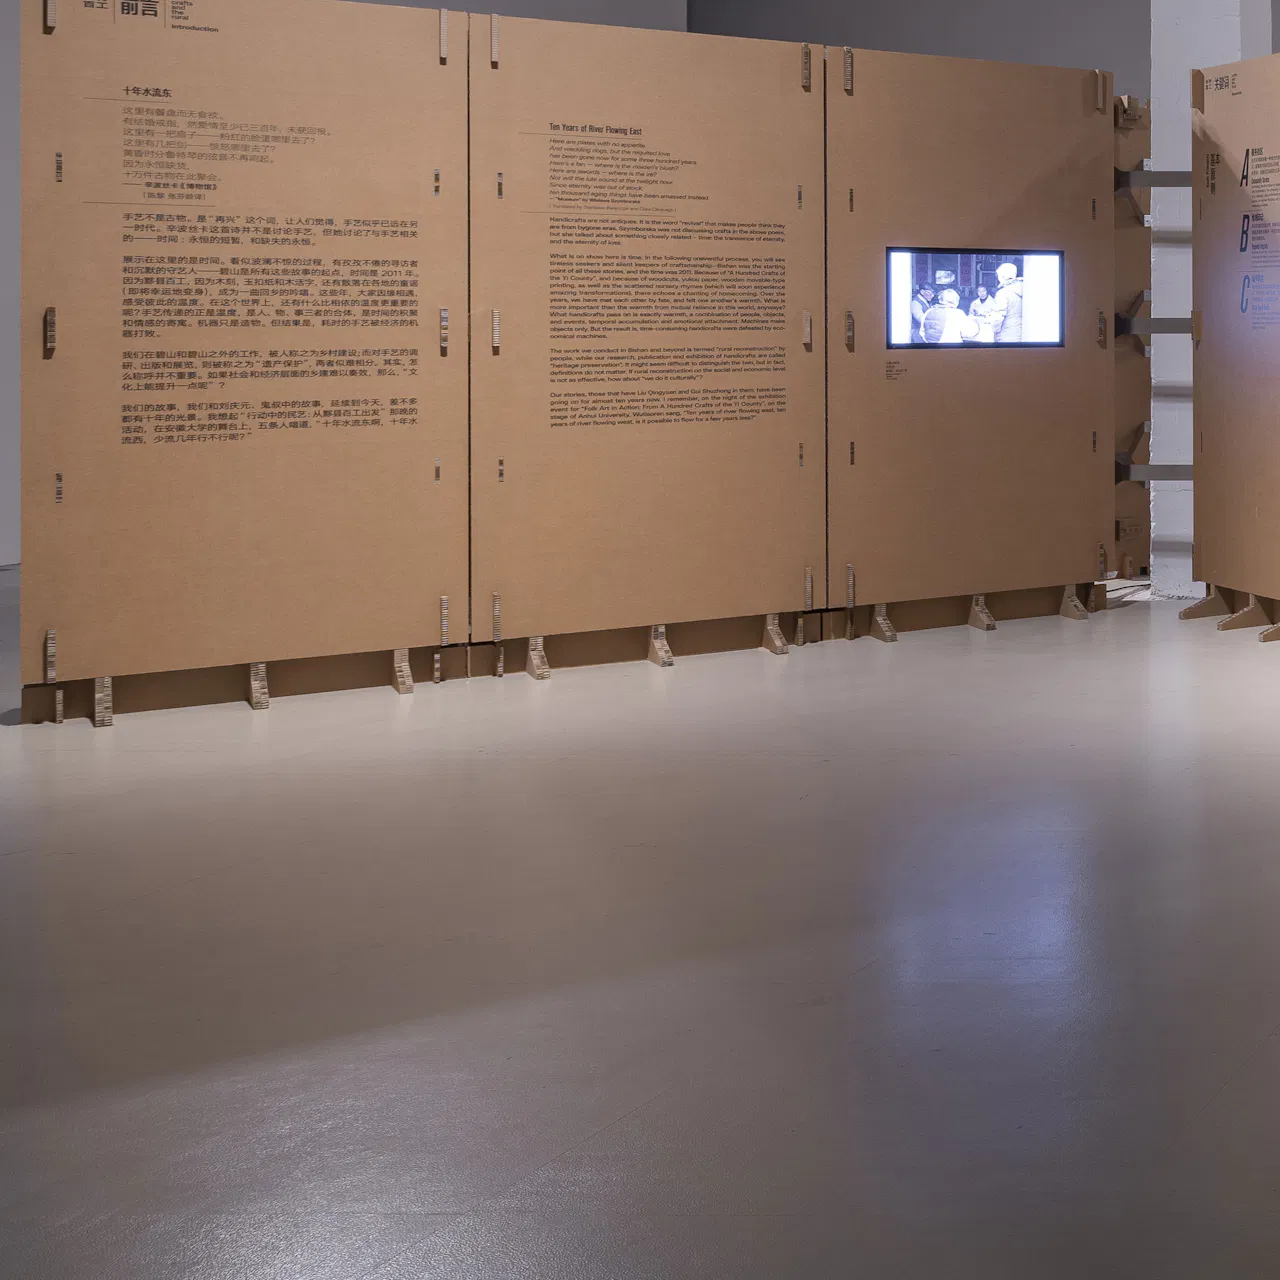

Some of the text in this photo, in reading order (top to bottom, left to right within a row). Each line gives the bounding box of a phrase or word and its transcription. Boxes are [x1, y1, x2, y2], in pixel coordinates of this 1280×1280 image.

[171, 23, 219, 33] introduction
[122, 85, 172, 98] 十年水流东
[549, 122, 642, 136] Ten Years of River Flowing East
[1240, 148, 1250, 187] A
[1239, 214, 1250, 253] B
[1240, 274, 1250, 314] C
